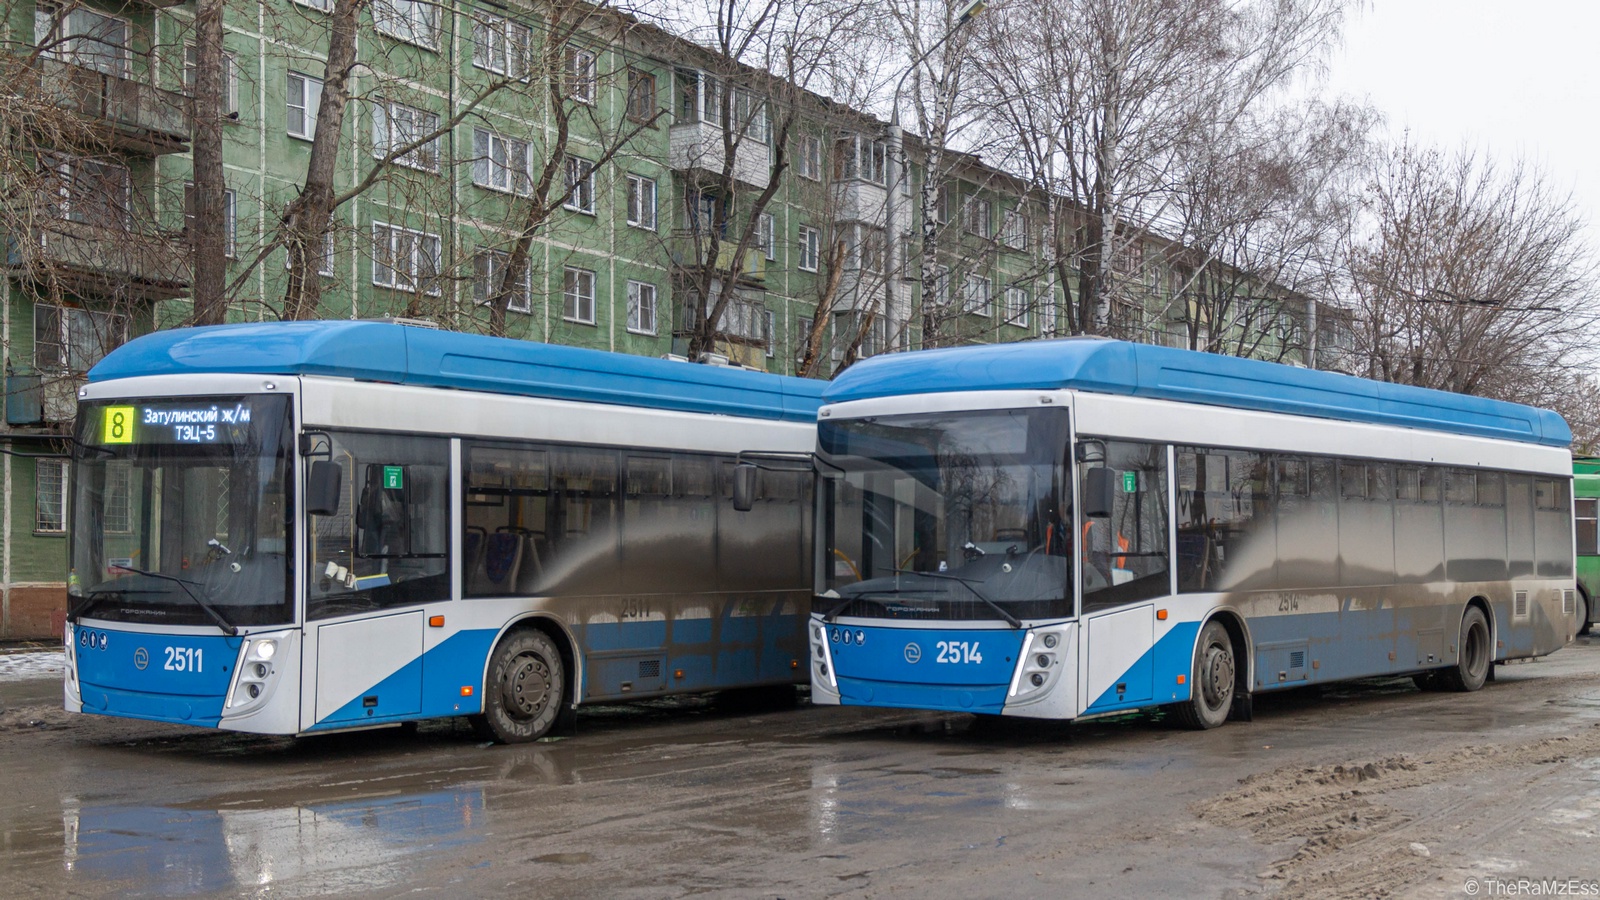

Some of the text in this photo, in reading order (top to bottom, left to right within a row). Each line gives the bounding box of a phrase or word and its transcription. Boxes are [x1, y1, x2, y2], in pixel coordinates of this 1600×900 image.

[111, 411, 126, 439] 8
[144, 404, 251, 425] Затулинский ж/м
[175, 425, 215, 442] ТЭЦ-5
[1278, 592, 1299, 611] 2514
[164, 646, 203, 673] 2511
[936, 640, 983, 665] 2514
